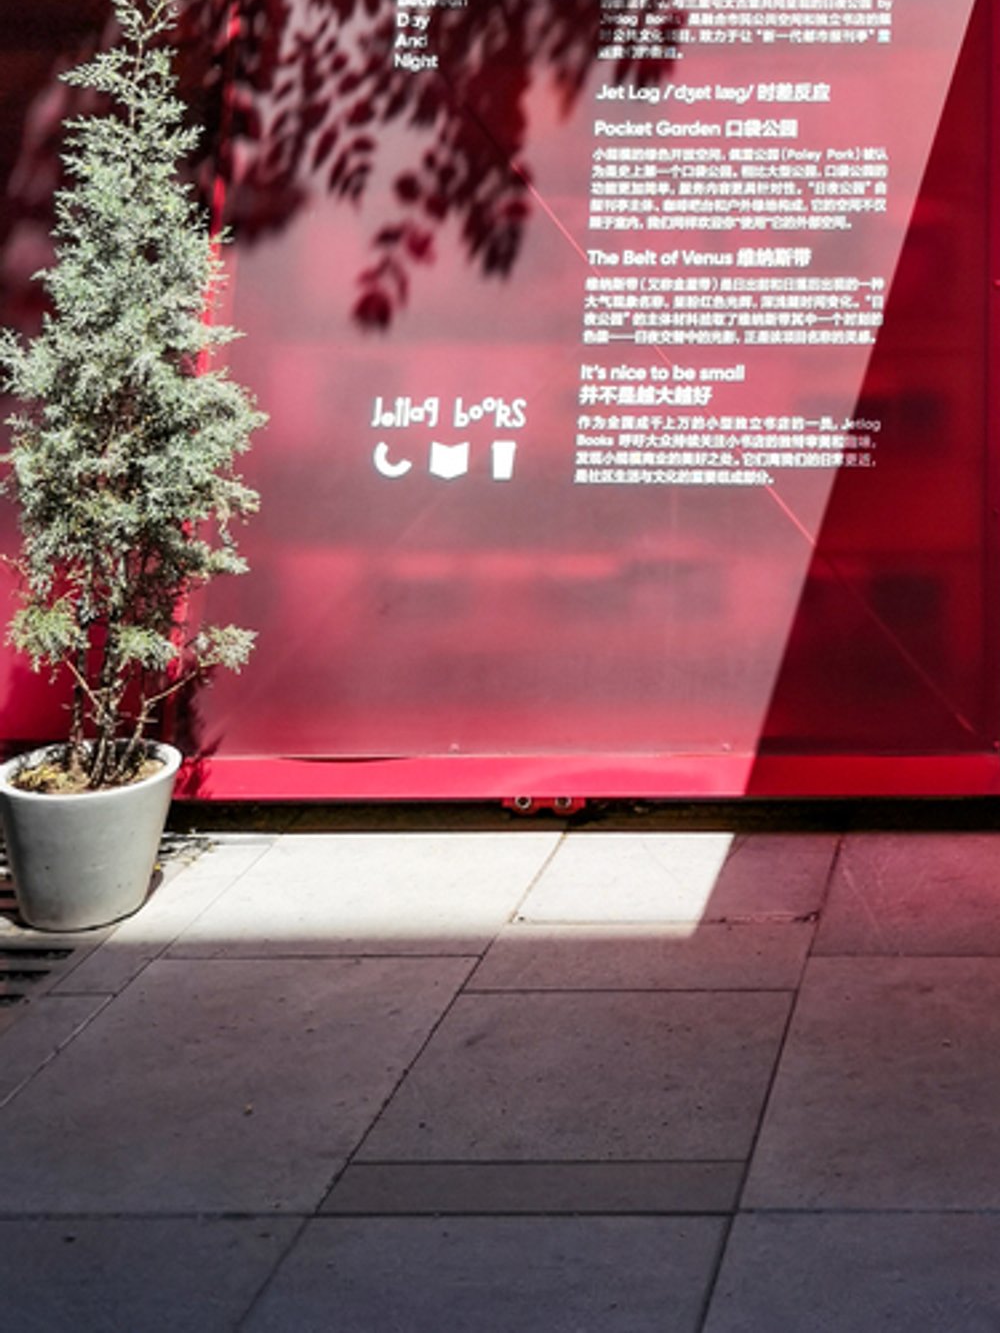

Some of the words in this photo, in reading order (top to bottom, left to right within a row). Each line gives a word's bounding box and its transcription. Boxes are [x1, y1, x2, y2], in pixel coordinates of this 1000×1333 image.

[397, 13, 430, 30] Day
[394, 33, 428, 48] And
[394, 53, 439, 72] Night
[596, 84, 625, 101] Jet
[628, 84, 660, 103] Lag
[594, 120, 653, 137] Pocket
[656, 120, 721, 137] Garden
[725, 119, 798, 138] 口袋公园
[588, 250, 620, 266] The
[623, 250, 657, 266] Belt
[660, 249, 679, 266] of
[682, 250, 734, 266] Venus
[611, 365, 647, 381] nice
[650, 366, 670, 381] to
[672, 365, 697, 381] be
[699, 365, 746, 381] small
[575, 434, 614, 448] Books
